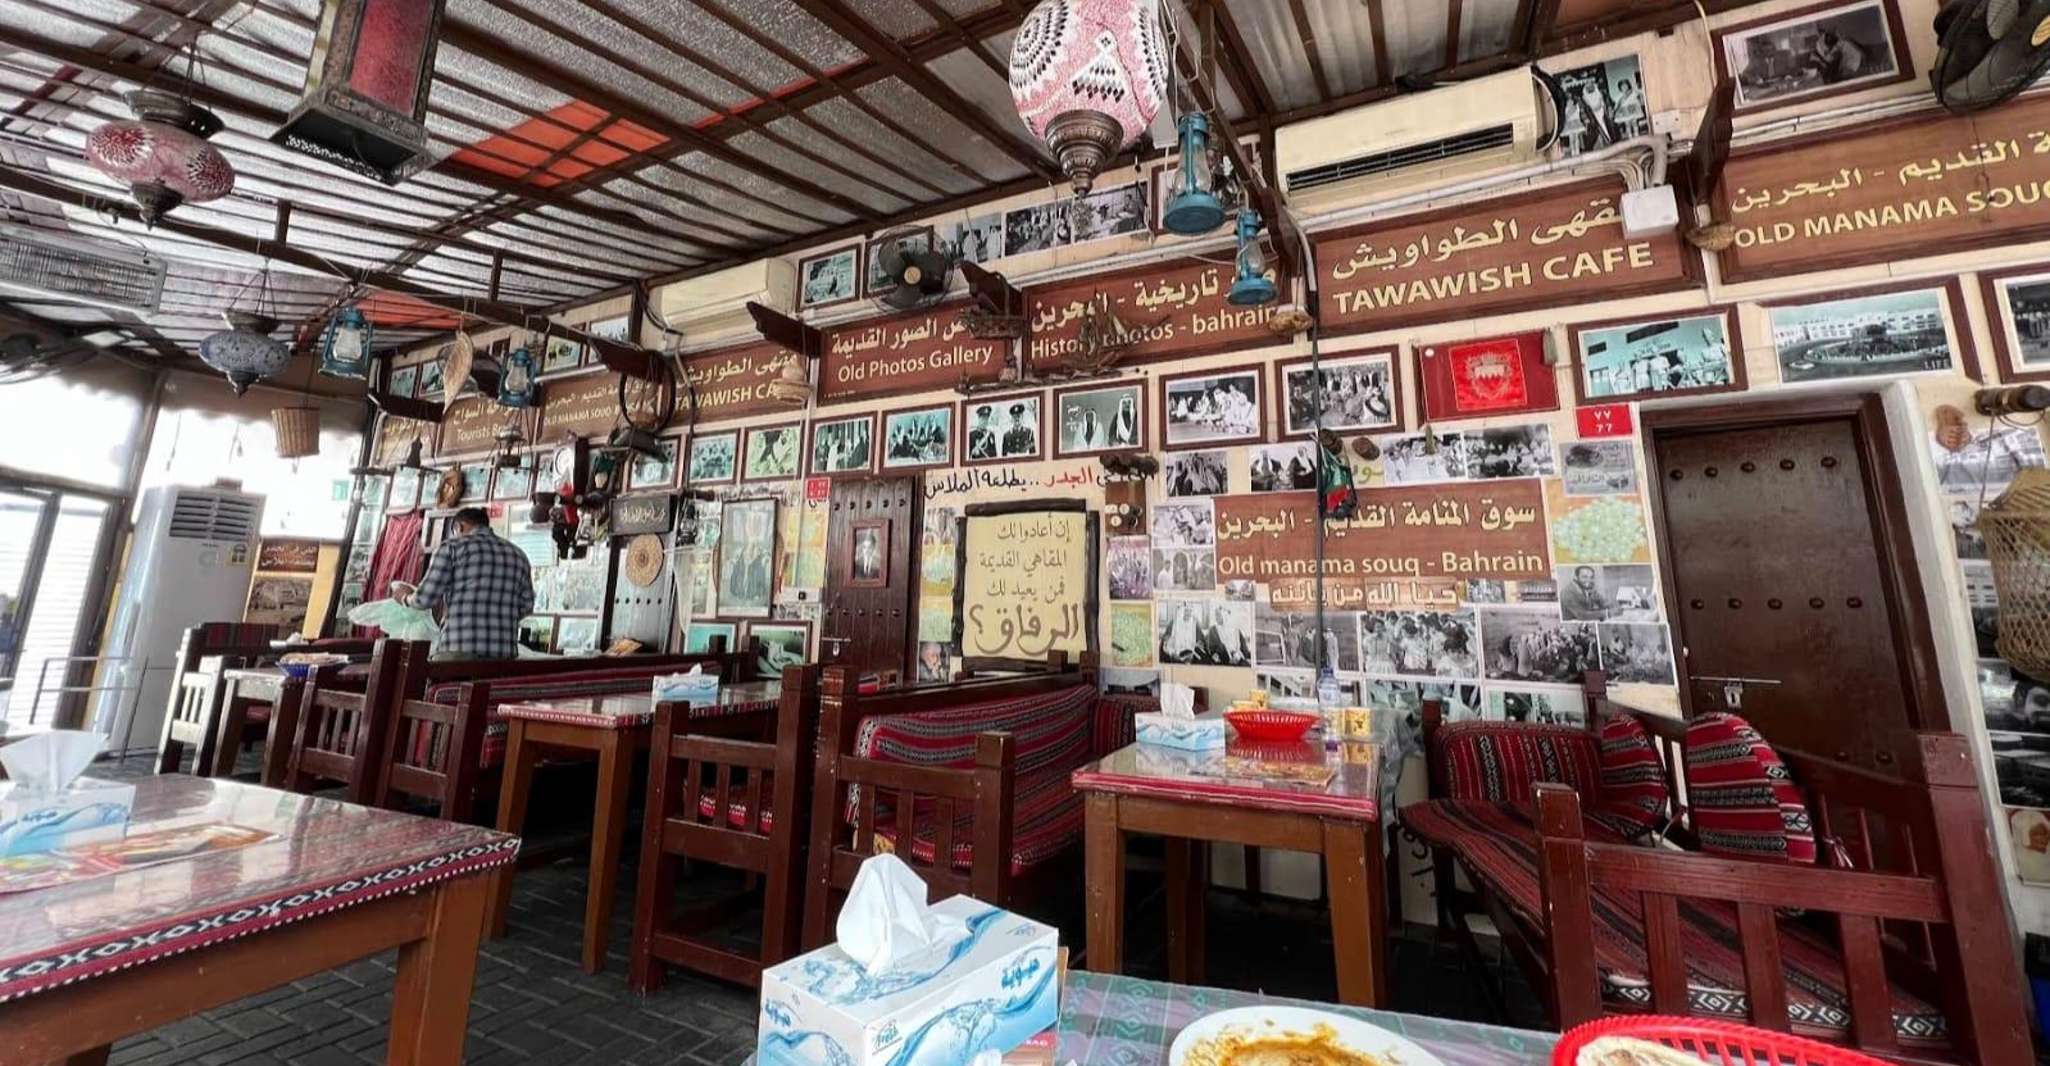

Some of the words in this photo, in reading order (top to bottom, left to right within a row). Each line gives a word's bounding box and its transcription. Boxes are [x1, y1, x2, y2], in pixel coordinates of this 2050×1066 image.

[1899, 138, 2020, 185] القديم
[1731, 166, 1864, 213] البحرين
[1530, 197, 1624, 246] قهى
[1735, 222, 1796, 248] OLD
[1803, 196, 1959, 238] MANAMA
[1332, 217, 1520, 281] الطواويش
[1133, 267, 1220, 313] تاريخية
[1332, 262, 1533, 315] TAWAWISH
[1542, 241, 1655, 281] CAFE
[831, 326, 887, 359] القديمة
[889, 316, 937, 351] الصور
[838, 362, 865, 383] Old
[869, 355, 925, 378] Photos
[929, 345, 993, 368] Gallery
[1217, 508, 1296, 540] البحرين
[1402, 498, 1470, 527] المنامة
[1481, 499, 1536, 531] سوق
[980, 550, 1020, 573] القديمة
[1023, 549, 1067, 578] المقاهي
[1218, 554, 1255, 575] Old
[1260, 557, 1355, 575] manama
[1362, 557, 1420, 578] souq
[1441, 550, 1543, 573] Bahrain
